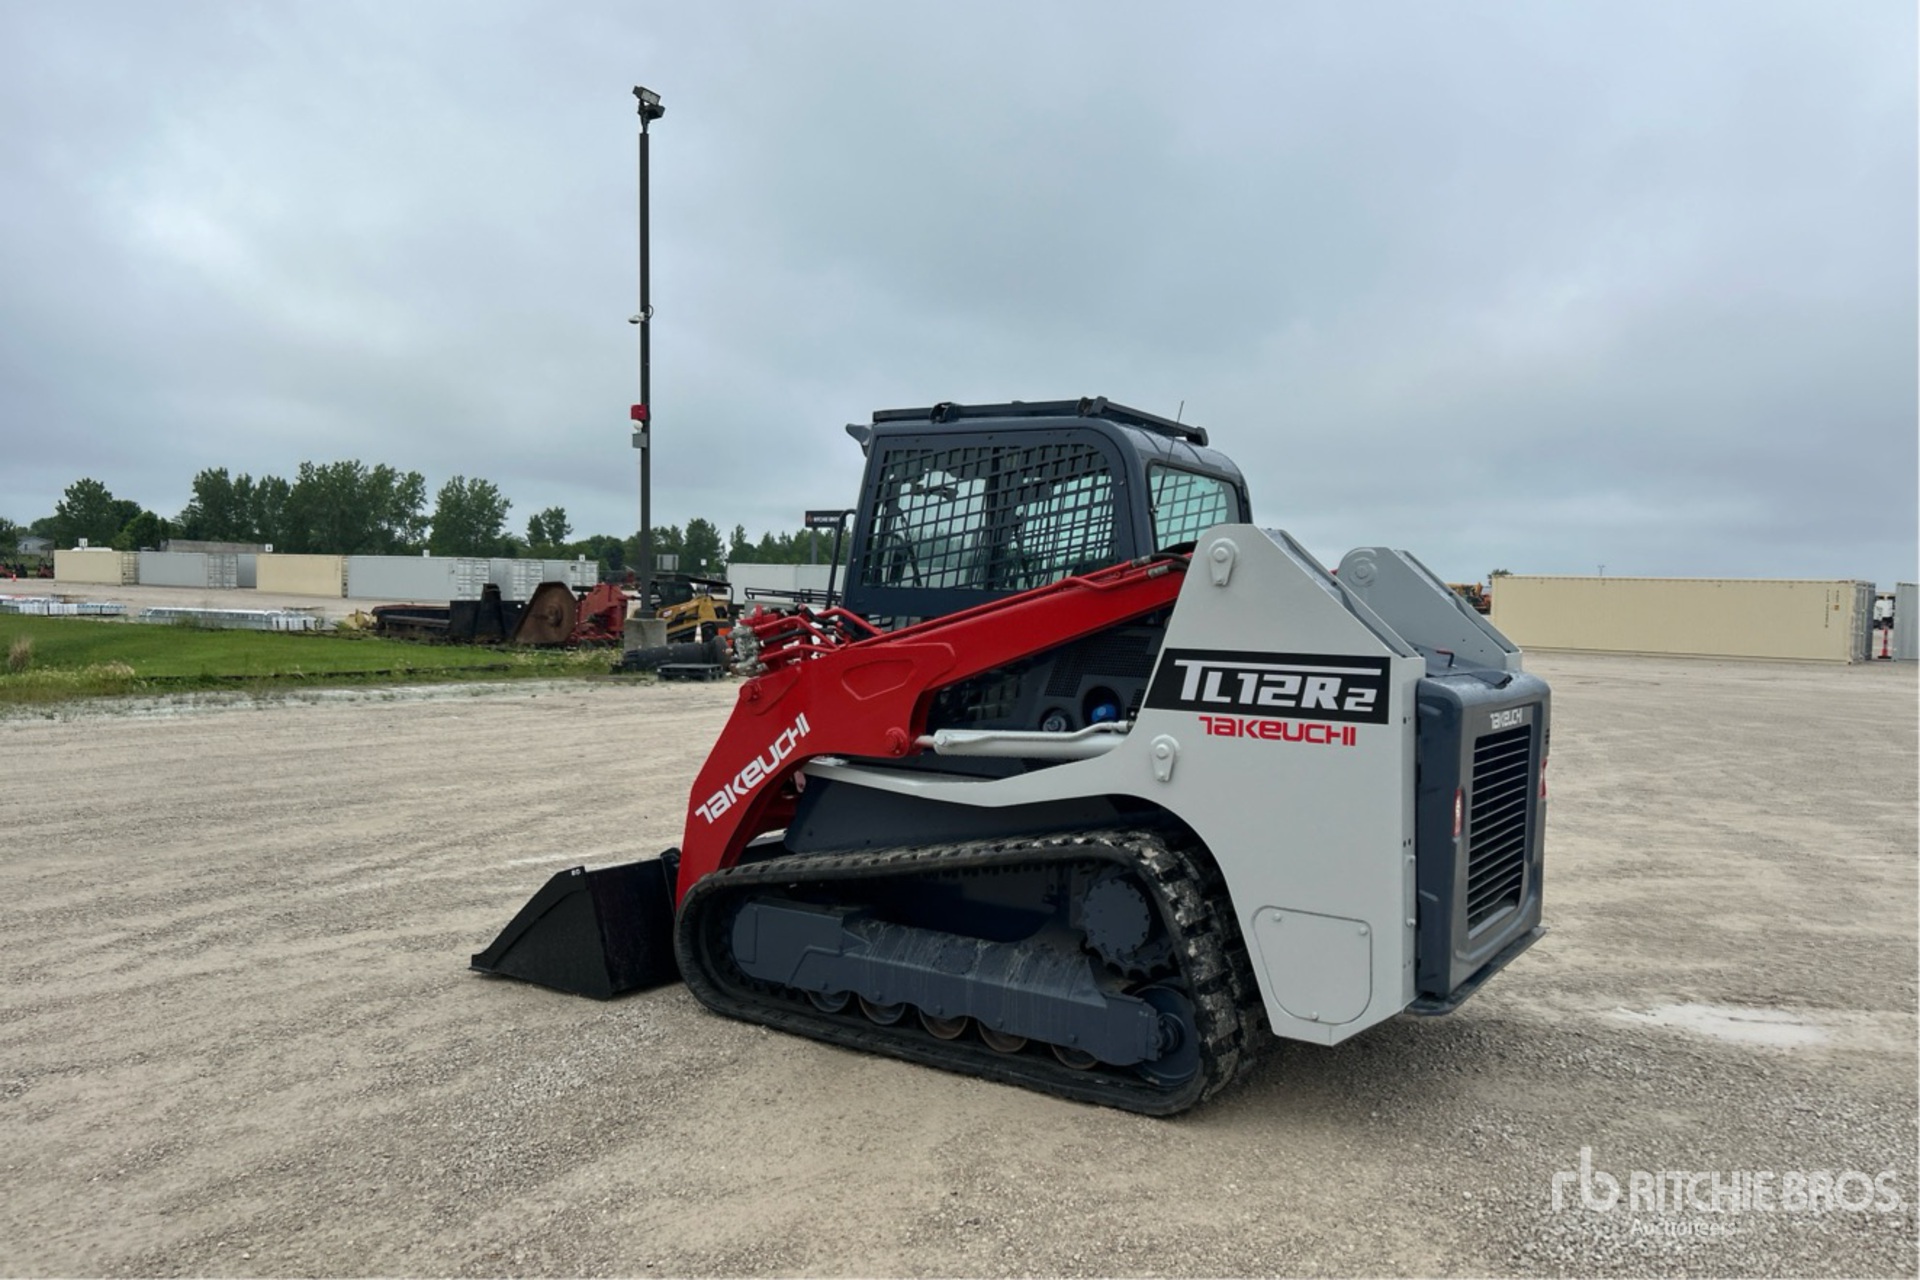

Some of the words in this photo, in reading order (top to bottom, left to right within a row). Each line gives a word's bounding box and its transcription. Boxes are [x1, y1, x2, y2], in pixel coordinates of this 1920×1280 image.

[1174, 659, 1382, 713] TL12R2
[1198, 716, 1356, 746] TAKEUCHI
[694, 712, 811, 824] TAKEUCHI
